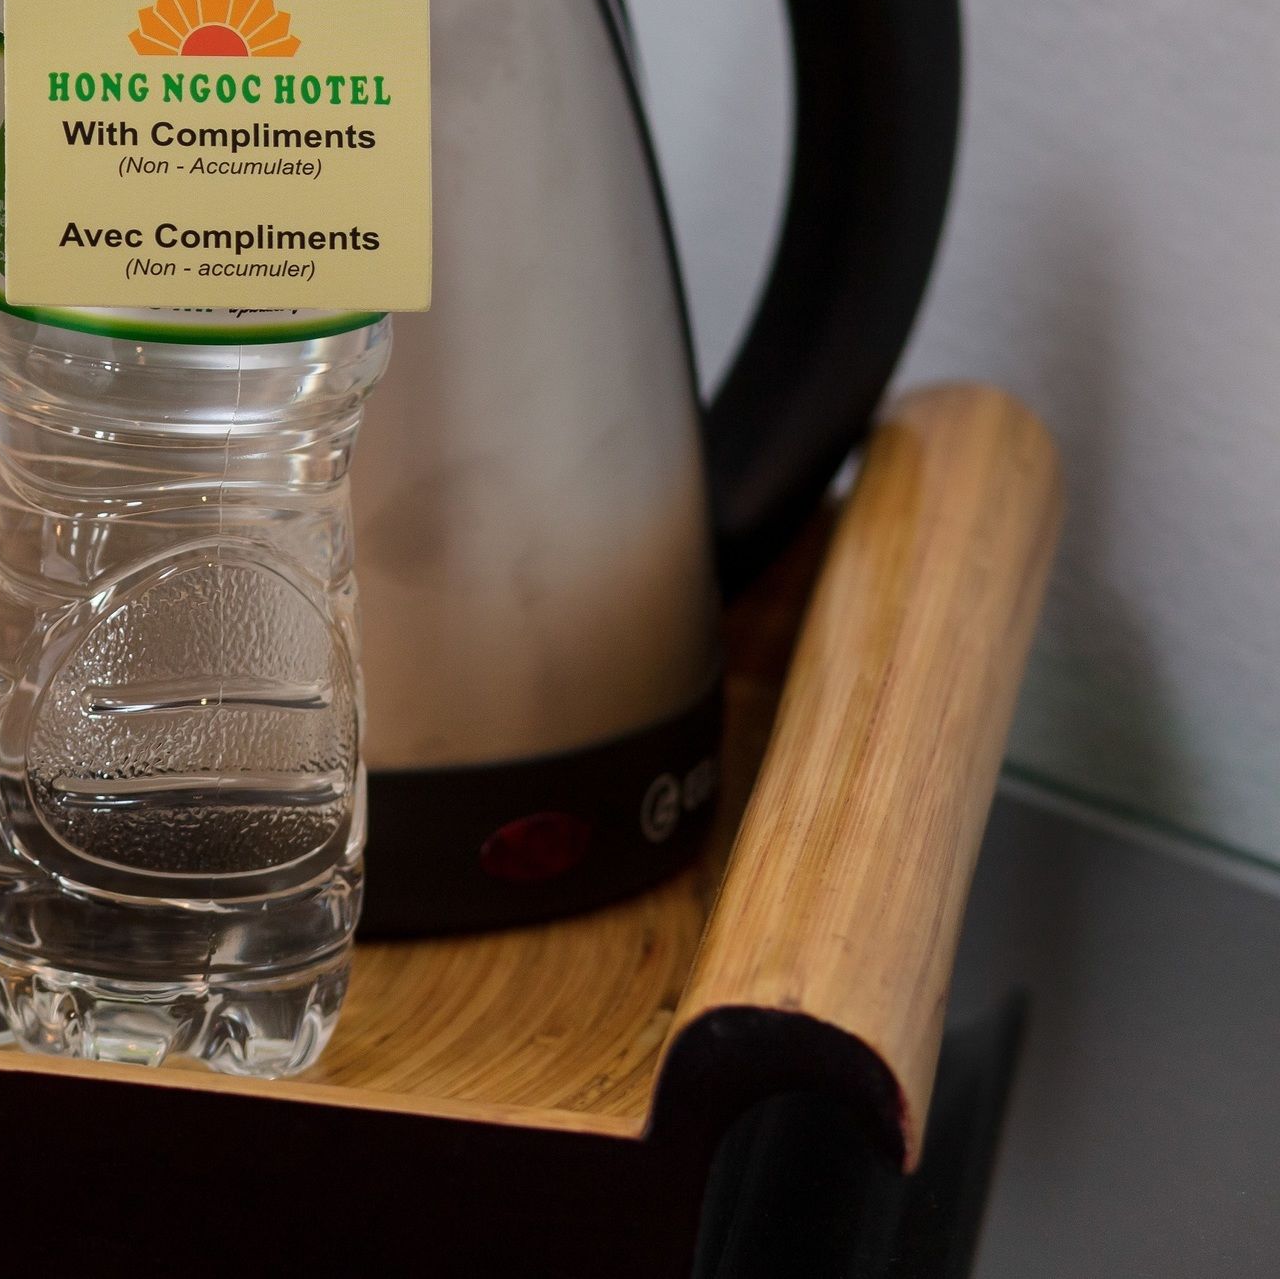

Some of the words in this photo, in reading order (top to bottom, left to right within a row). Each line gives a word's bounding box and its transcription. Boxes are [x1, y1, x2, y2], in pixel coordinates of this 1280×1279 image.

[47, 72, 150, 103] HONG
[162, 73, 261, 104] NGOC
[274, 74, 392, 106] HOTEL
[62, 120, 139, 146] With
[150, 121, 377, 153] Compliments
[118, 156, 169, 177] (Non
[189, 156, 322, 179] Accumulate)
[59, 222, 143, 248] Avec
[154, 223, 381, 255] Compliments
[125, 258, 177, 279] (Non
[197, 259, 316, 282] accumuler)
